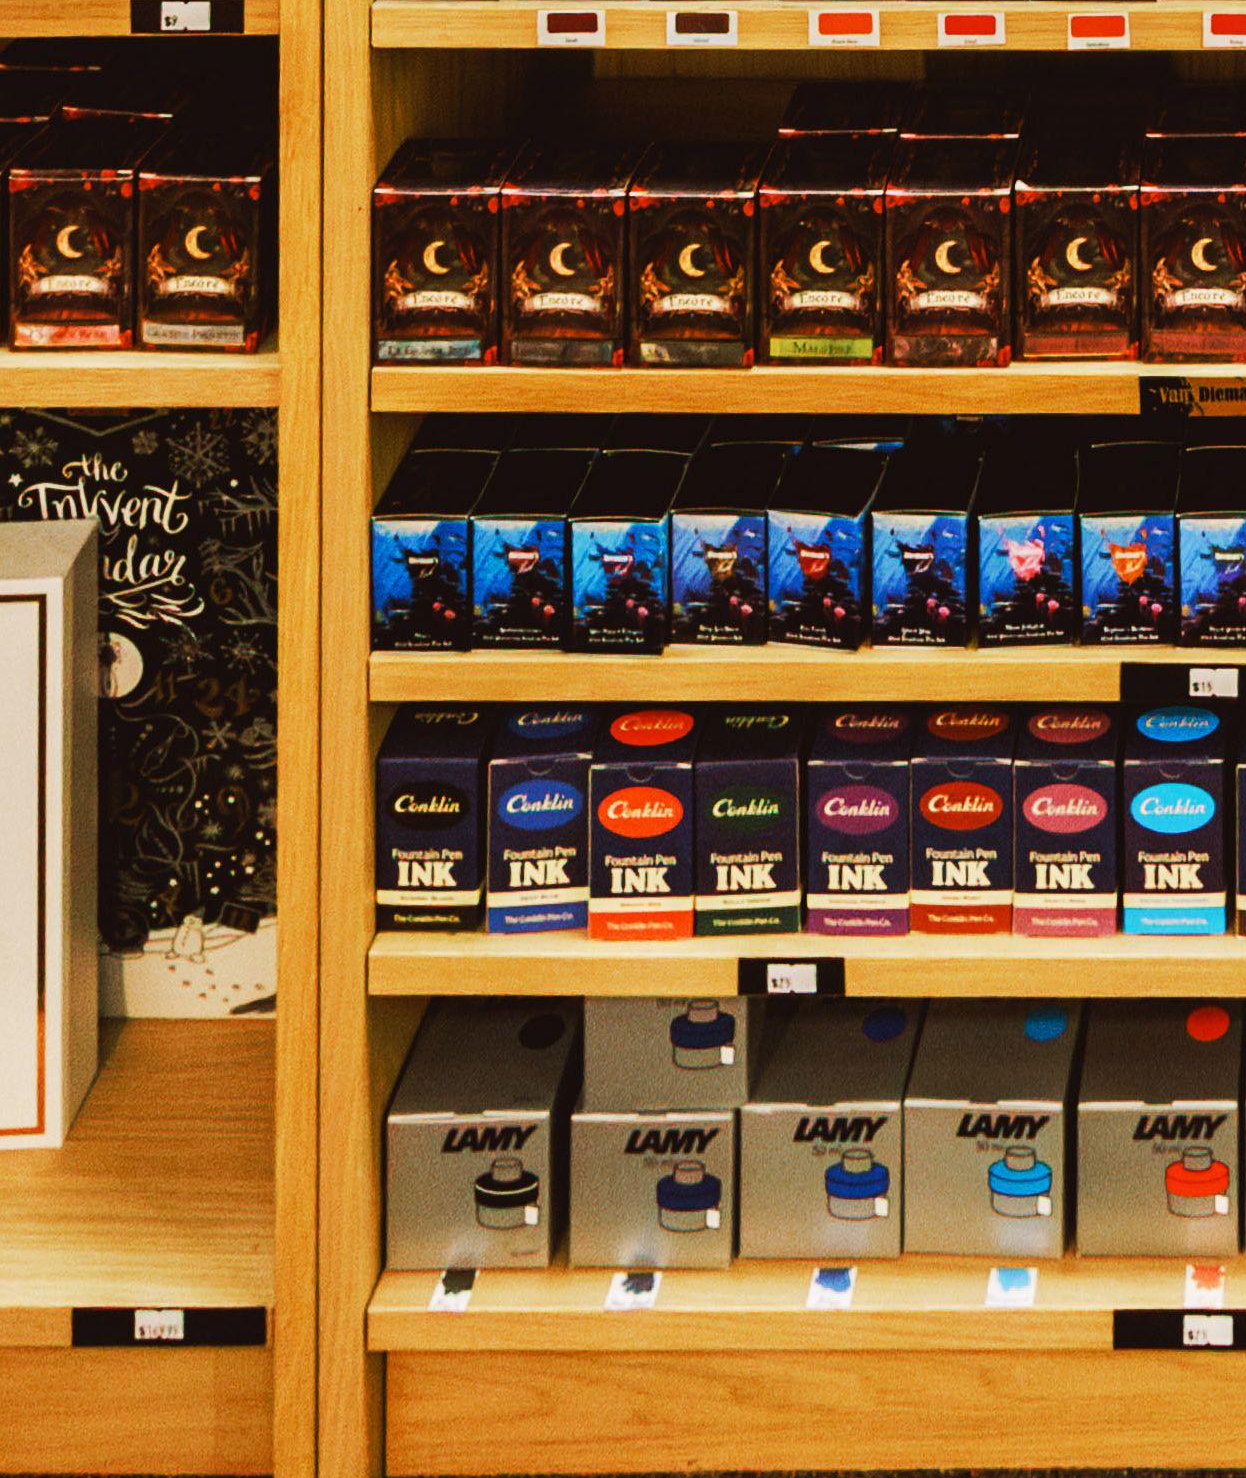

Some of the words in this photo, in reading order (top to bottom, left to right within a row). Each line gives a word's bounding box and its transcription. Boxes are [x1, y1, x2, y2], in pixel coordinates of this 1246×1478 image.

[394, 796, 460, 813] Conklin
[506, 795, 574, 813] Conklin
[607, 803, 674, 820] Conklin
[712, 800, 779, 817] Conklin
[823, 800, 891, 817] Conklin
[928, 795, 995, 814] Conklin
[1031, 796, 1098, 815] Conklin
[1140, 796, 1206, 815] Conklin
[391, 849, 436, 860] Fountain
[440, 849, 463, 859] Pen
[398, 862, 457, 887] INK
[509, 861, 569, 886] INK
[611, 868, 670, 893] INK
[716, 865, 776, 891] INK
[827, 865, 887, 891] INK
[932, 862, 991, 887] INK
[1036, 864, 1094, 889] INK
[1144, 864, 1203, 889] INK
[793, 1117, 887, 1144] LAMY
[956, 1114, 1049, 1139] LAMY
[1133, 1115, 1227, 1140] LAMY
[442, 1125, 537, 1154] LAMY
[624, 1128, 719, 1155] LAMY
